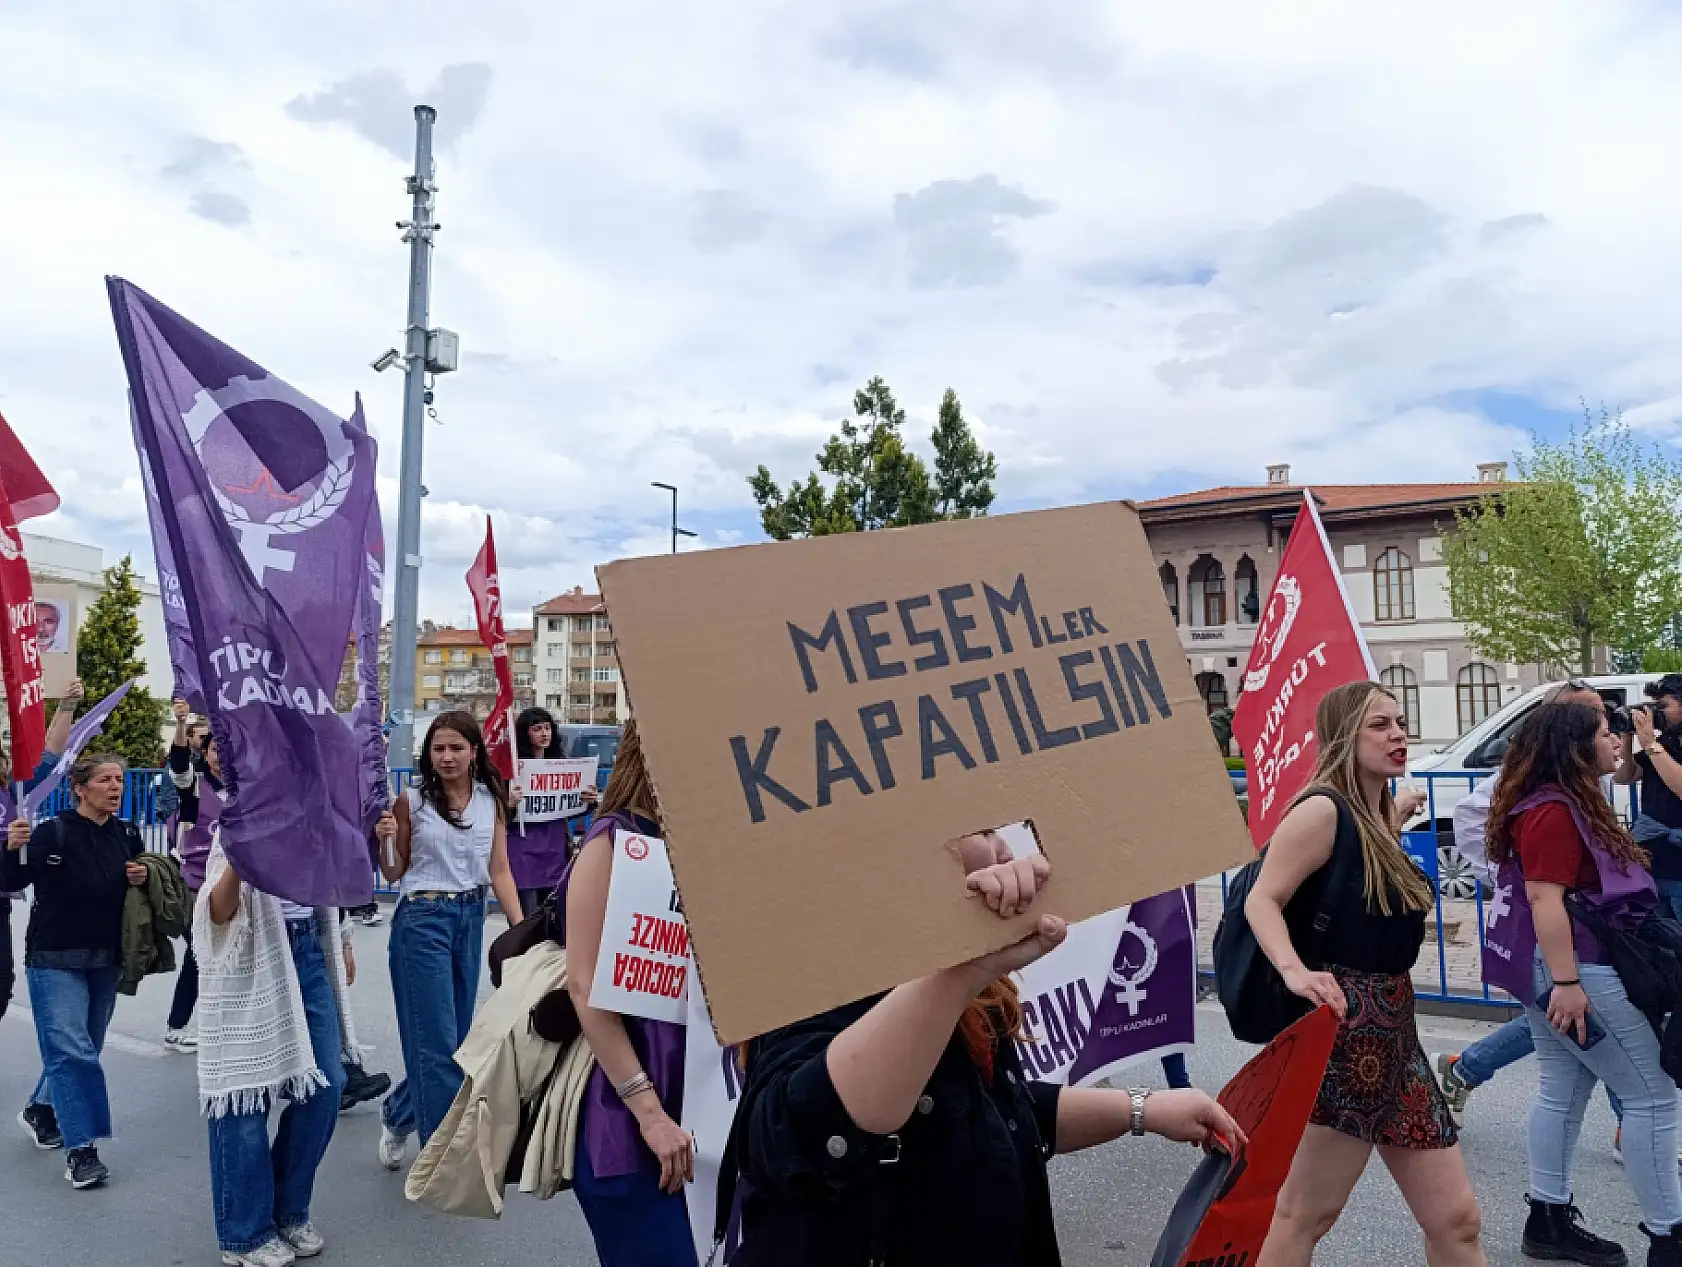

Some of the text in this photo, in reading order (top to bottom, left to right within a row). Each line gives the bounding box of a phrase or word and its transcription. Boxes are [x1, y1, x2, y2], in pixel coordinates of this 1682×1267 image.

[785, 573, 1109, 693] MESEMLER
[729, 638, 1173, 824] KAPATILSIN
[629, 913, 690, 959] NİNİZE
